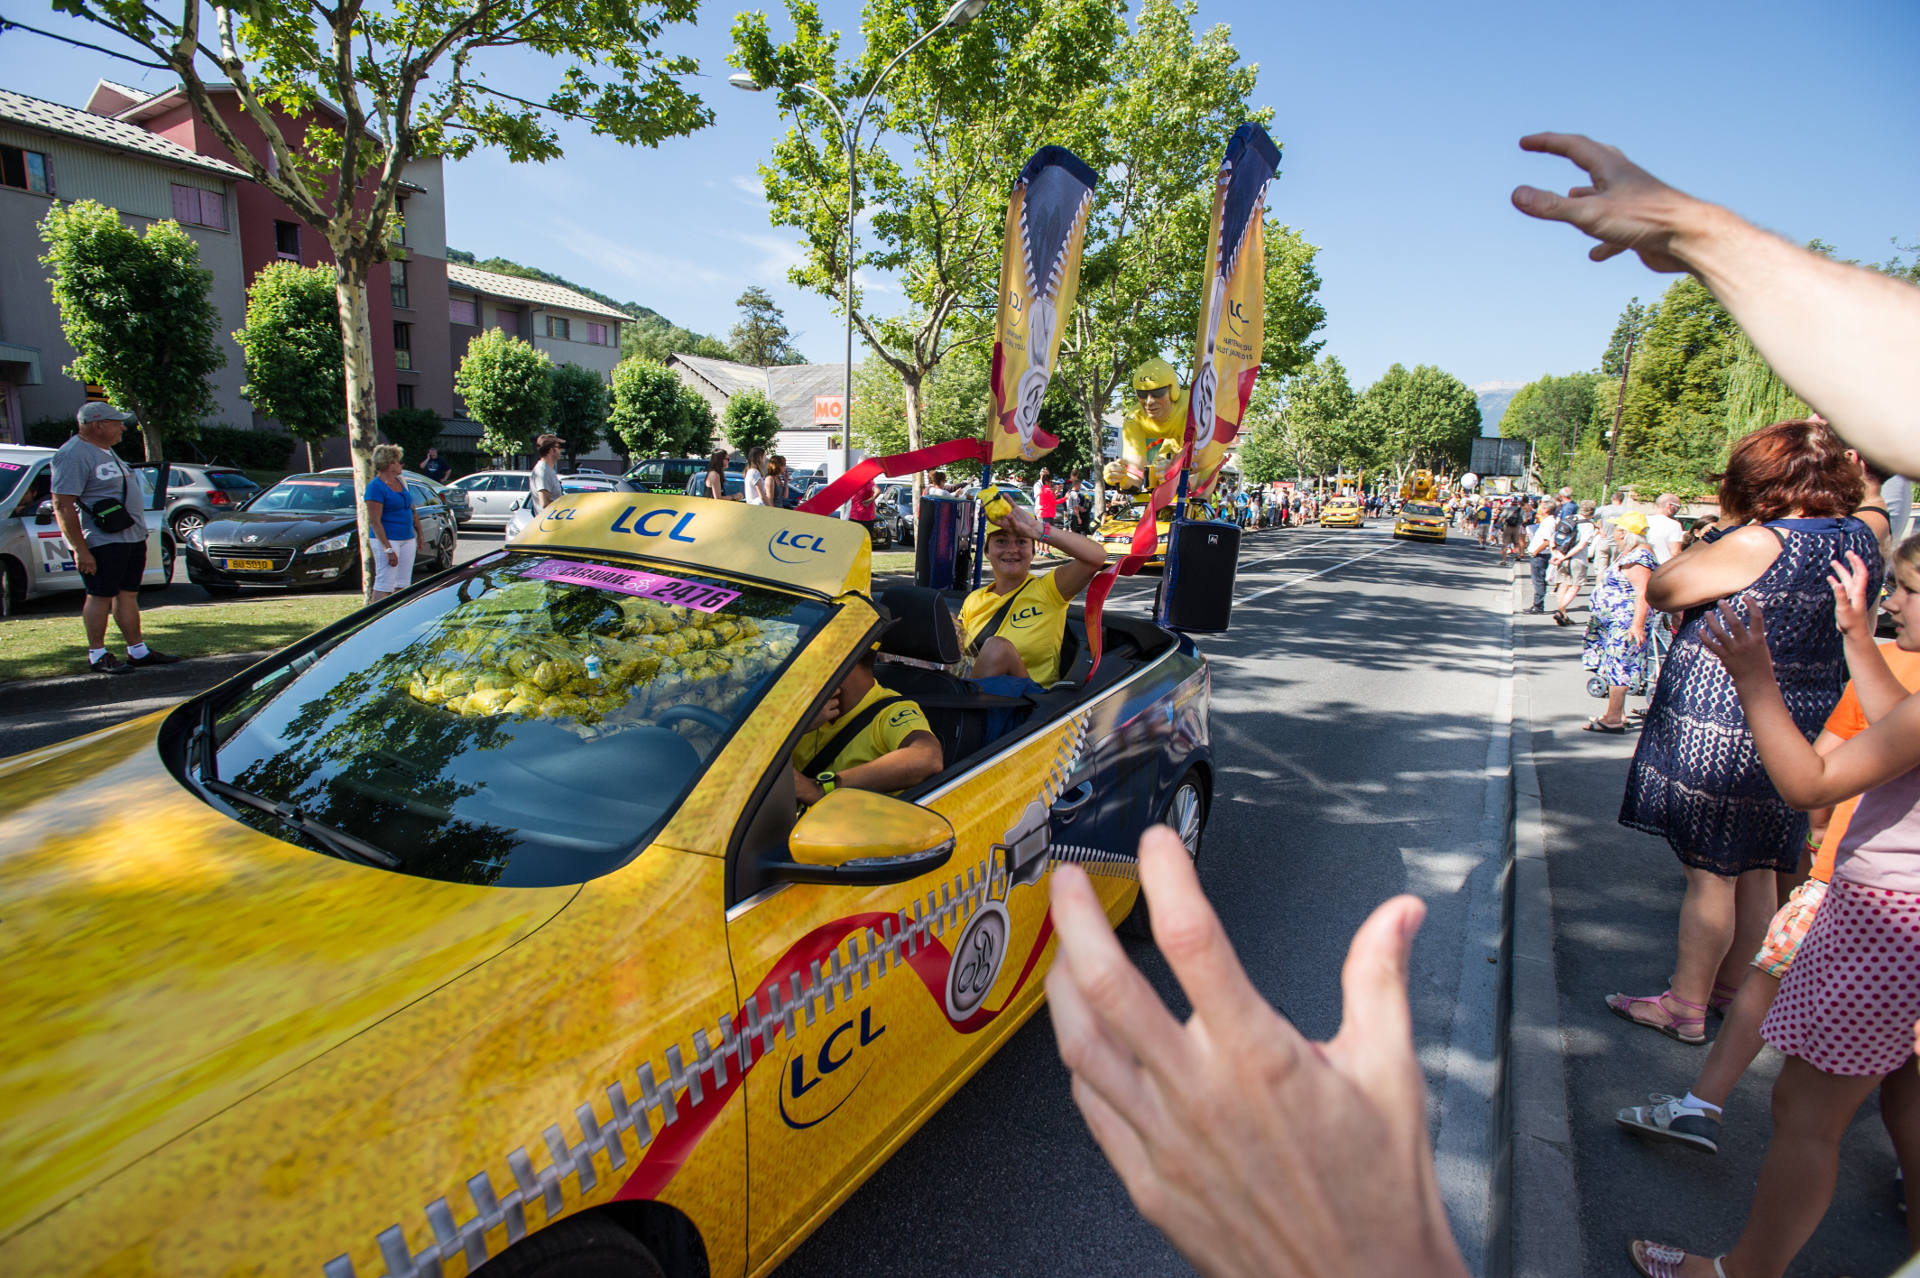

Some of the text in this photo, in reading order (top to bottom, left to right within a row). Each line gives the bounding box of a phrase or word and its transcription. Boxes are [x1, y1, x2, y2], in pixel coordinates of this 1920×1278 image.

[547, 508, 577, 520] LCL
[610, 505, 697, 544] LCL
[776, 529, 827, 553] LCL
[558, 566, 637, 586] CARAVANE
[651, 581, 732, 609] 2476
[1012, 606, 1043, 622] LCL
[790, 1006, 886, 1099] LCL
